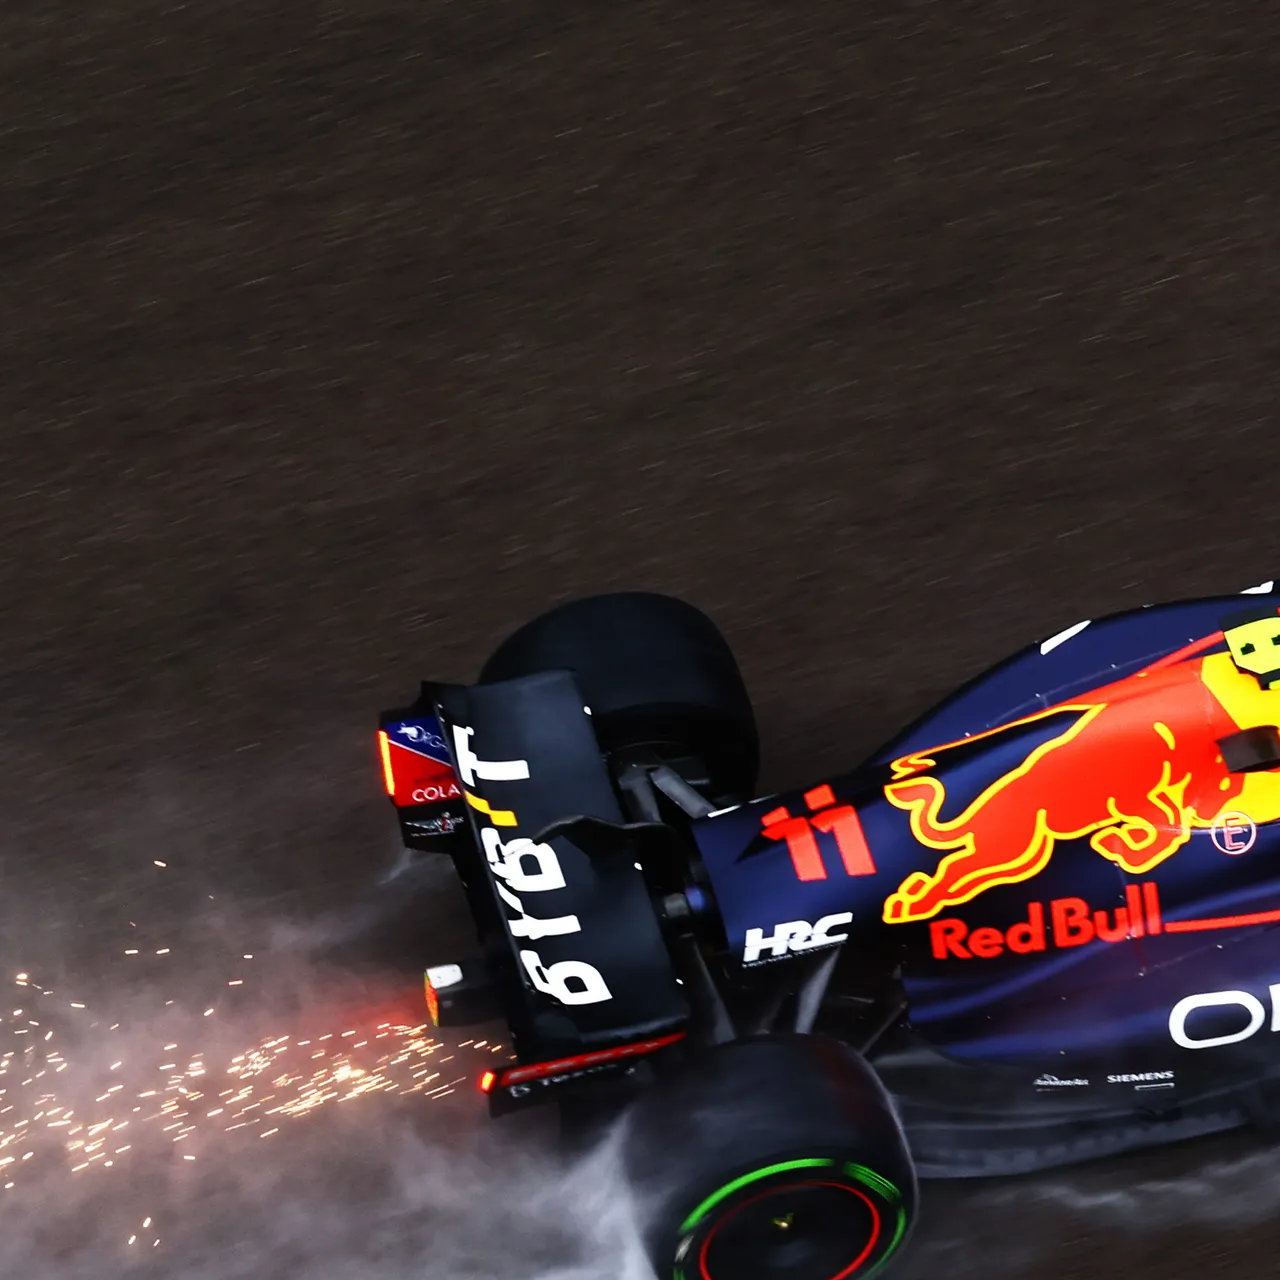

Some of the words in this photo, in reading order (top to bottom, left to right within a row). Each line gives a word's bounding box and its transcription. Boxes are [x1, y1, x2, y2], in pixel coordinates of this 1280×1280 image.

[412, 784, 461, 802] COLA
[452, 725, 613, 1005] BYBIT
[760, 784, 877, 882] 11
[743, 911, 853, 962] HRC
[930, 901, 1045, 959] Red
[1051, 882, 1163, 947] Bull
[1107, 1070, 1175, 1083] SIEMENS
